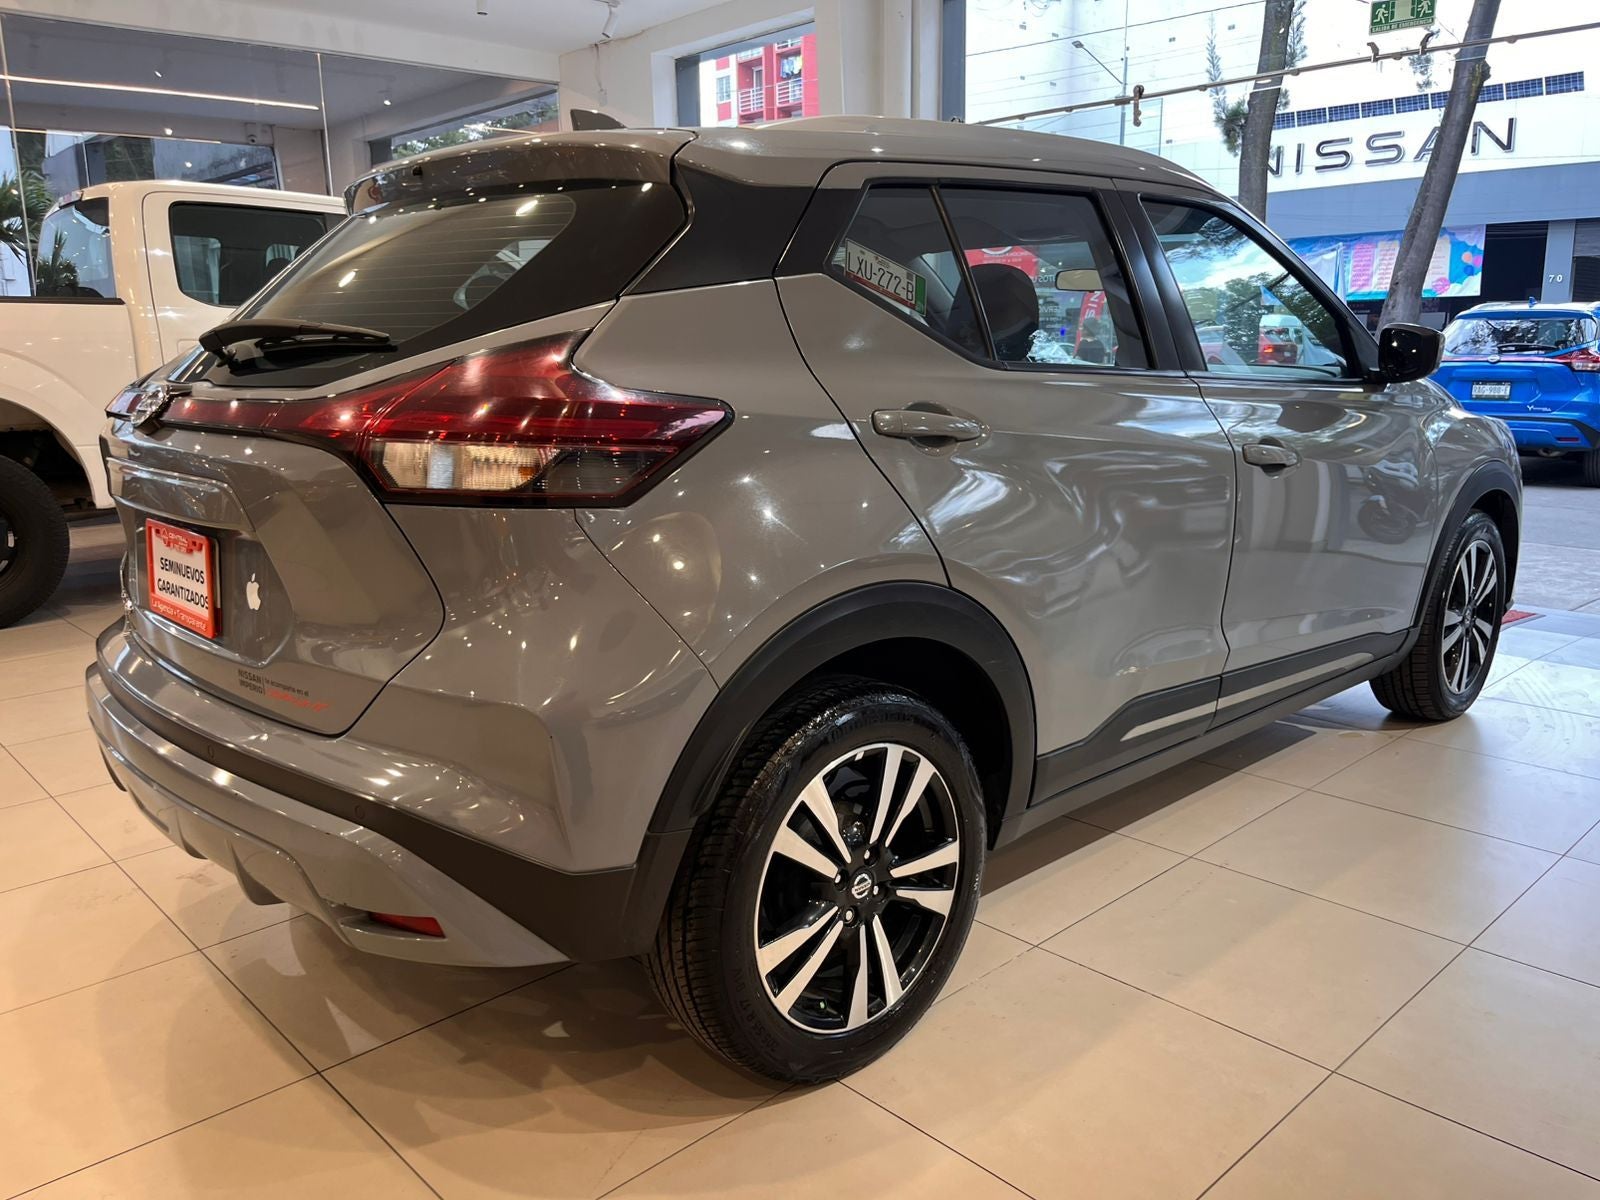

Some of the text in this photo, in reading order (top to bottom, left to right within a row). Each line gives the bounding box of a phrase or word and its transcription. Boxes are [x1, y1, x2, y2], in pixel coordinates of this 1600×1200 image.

[847, 251, 914, 302] LXU-272-B
[1548, 274, 1563, 283] 70
[160, 557, 205, 584] SEMINUEVOS
[157, 578, 209, 610] GARANTIZADOS
[238, 669, 262, 684] NISSAN
